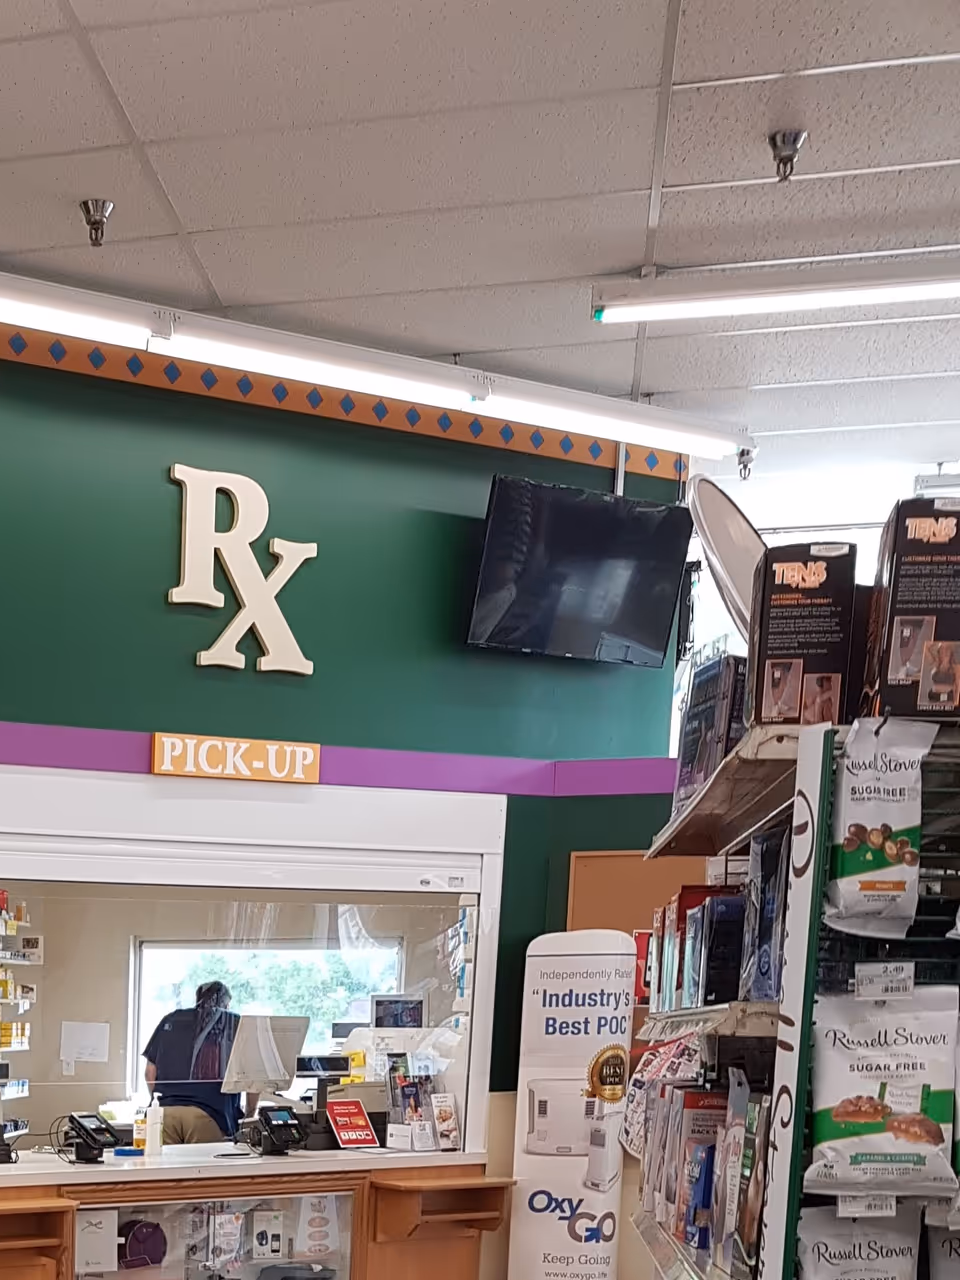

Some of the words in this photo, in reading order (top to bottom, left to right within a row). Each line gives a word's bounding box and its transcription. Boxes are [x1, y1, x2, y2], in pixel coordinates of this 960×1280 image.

[160, 736, 315, 780] PICK-UP
[540, 969, 612, 983] Independently
[544, 1016, 591, 1036] Best
[825, 1027, 890, 1051] Russell
[893, 1026, 949, 1046] Stover
[849, 1063, 891, 1072] SUGAR
[895, 1062, 926, 1071] FREE
[542, 1253, 575, 1266] Keep
[579, 1253, 611, 1267] Going
[812, 1241, 867, 1265] Russell
[867, 1240, 914, 1261] Stover
[544, 1269, 609, 1280] www.oxygo.life
